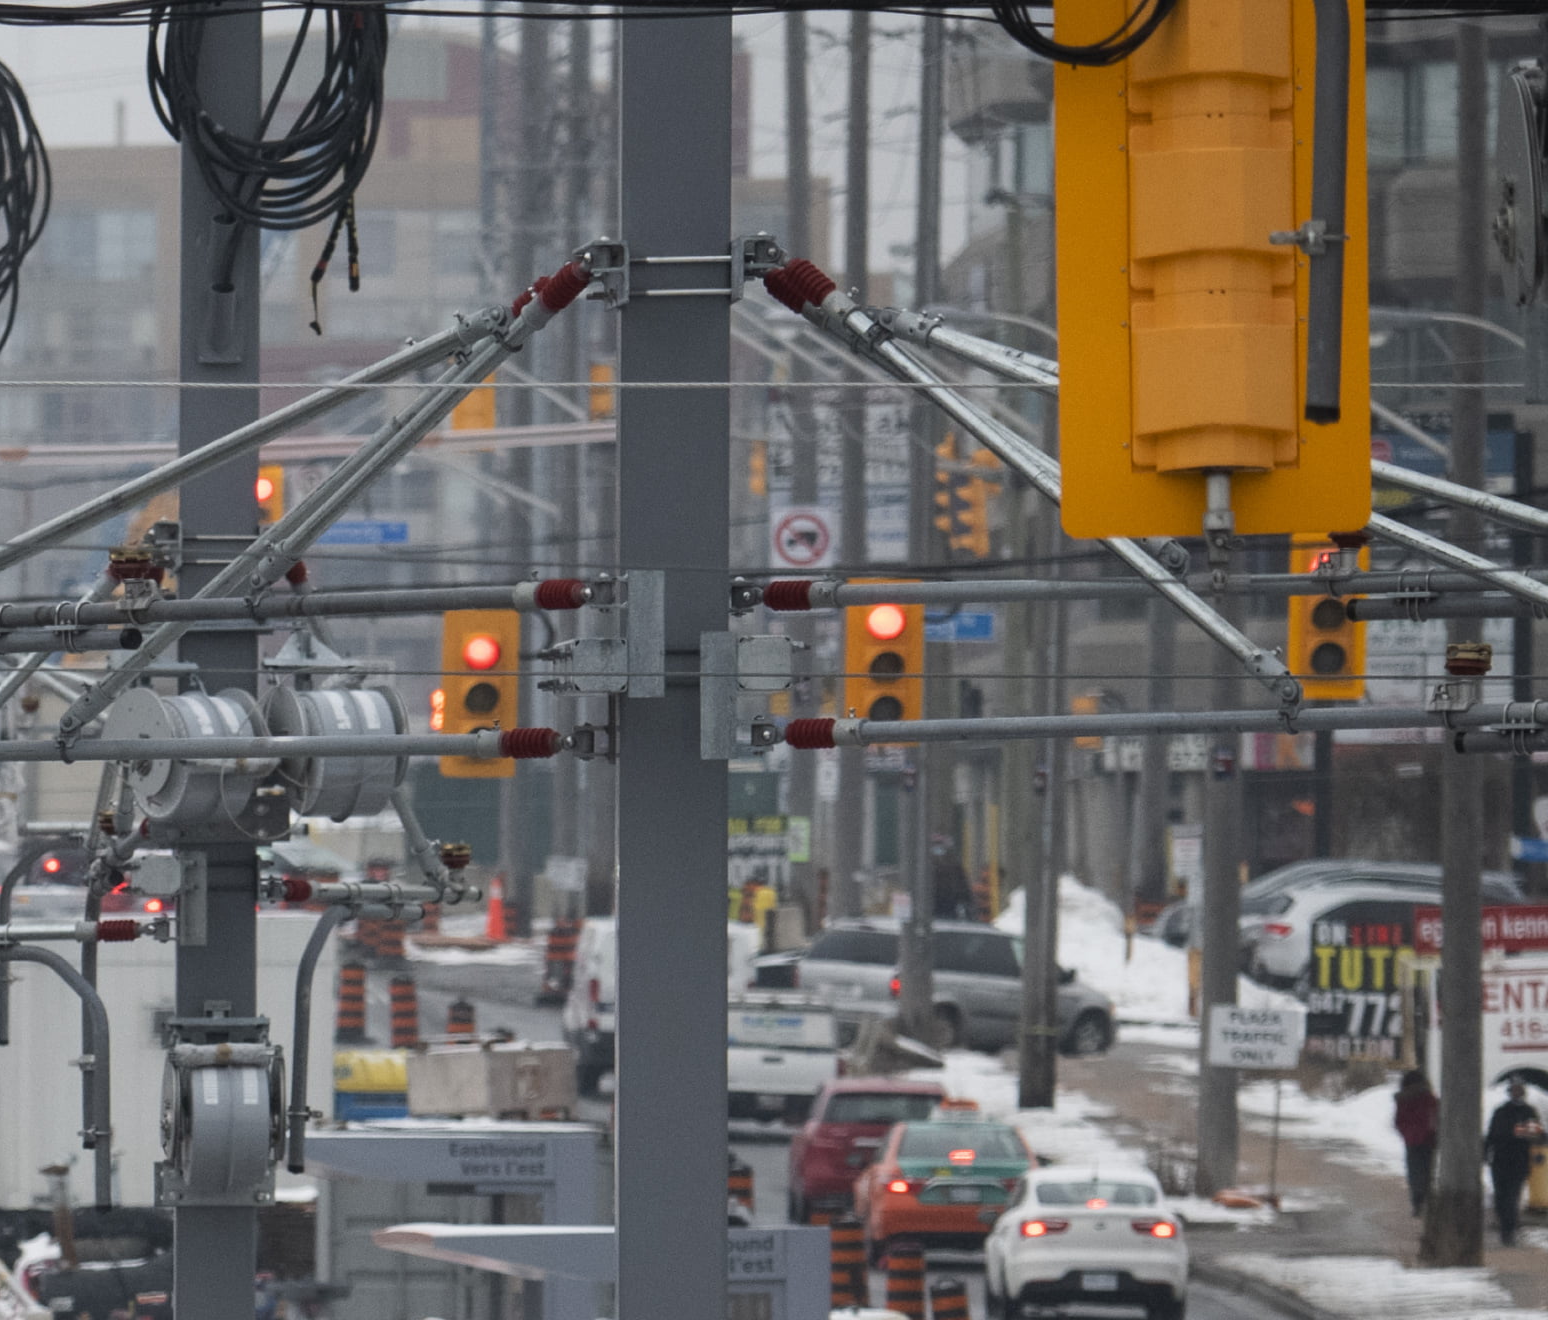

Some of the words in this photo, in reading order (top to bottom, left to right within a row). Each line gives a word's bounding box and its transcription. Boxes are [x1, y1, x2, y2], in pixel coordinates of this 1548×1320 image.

[1483, 981, 1548, 1013] ENT
[449, 1140, 547, 1159] Eastbound
[460, 1161, 501, 1178] Vers
